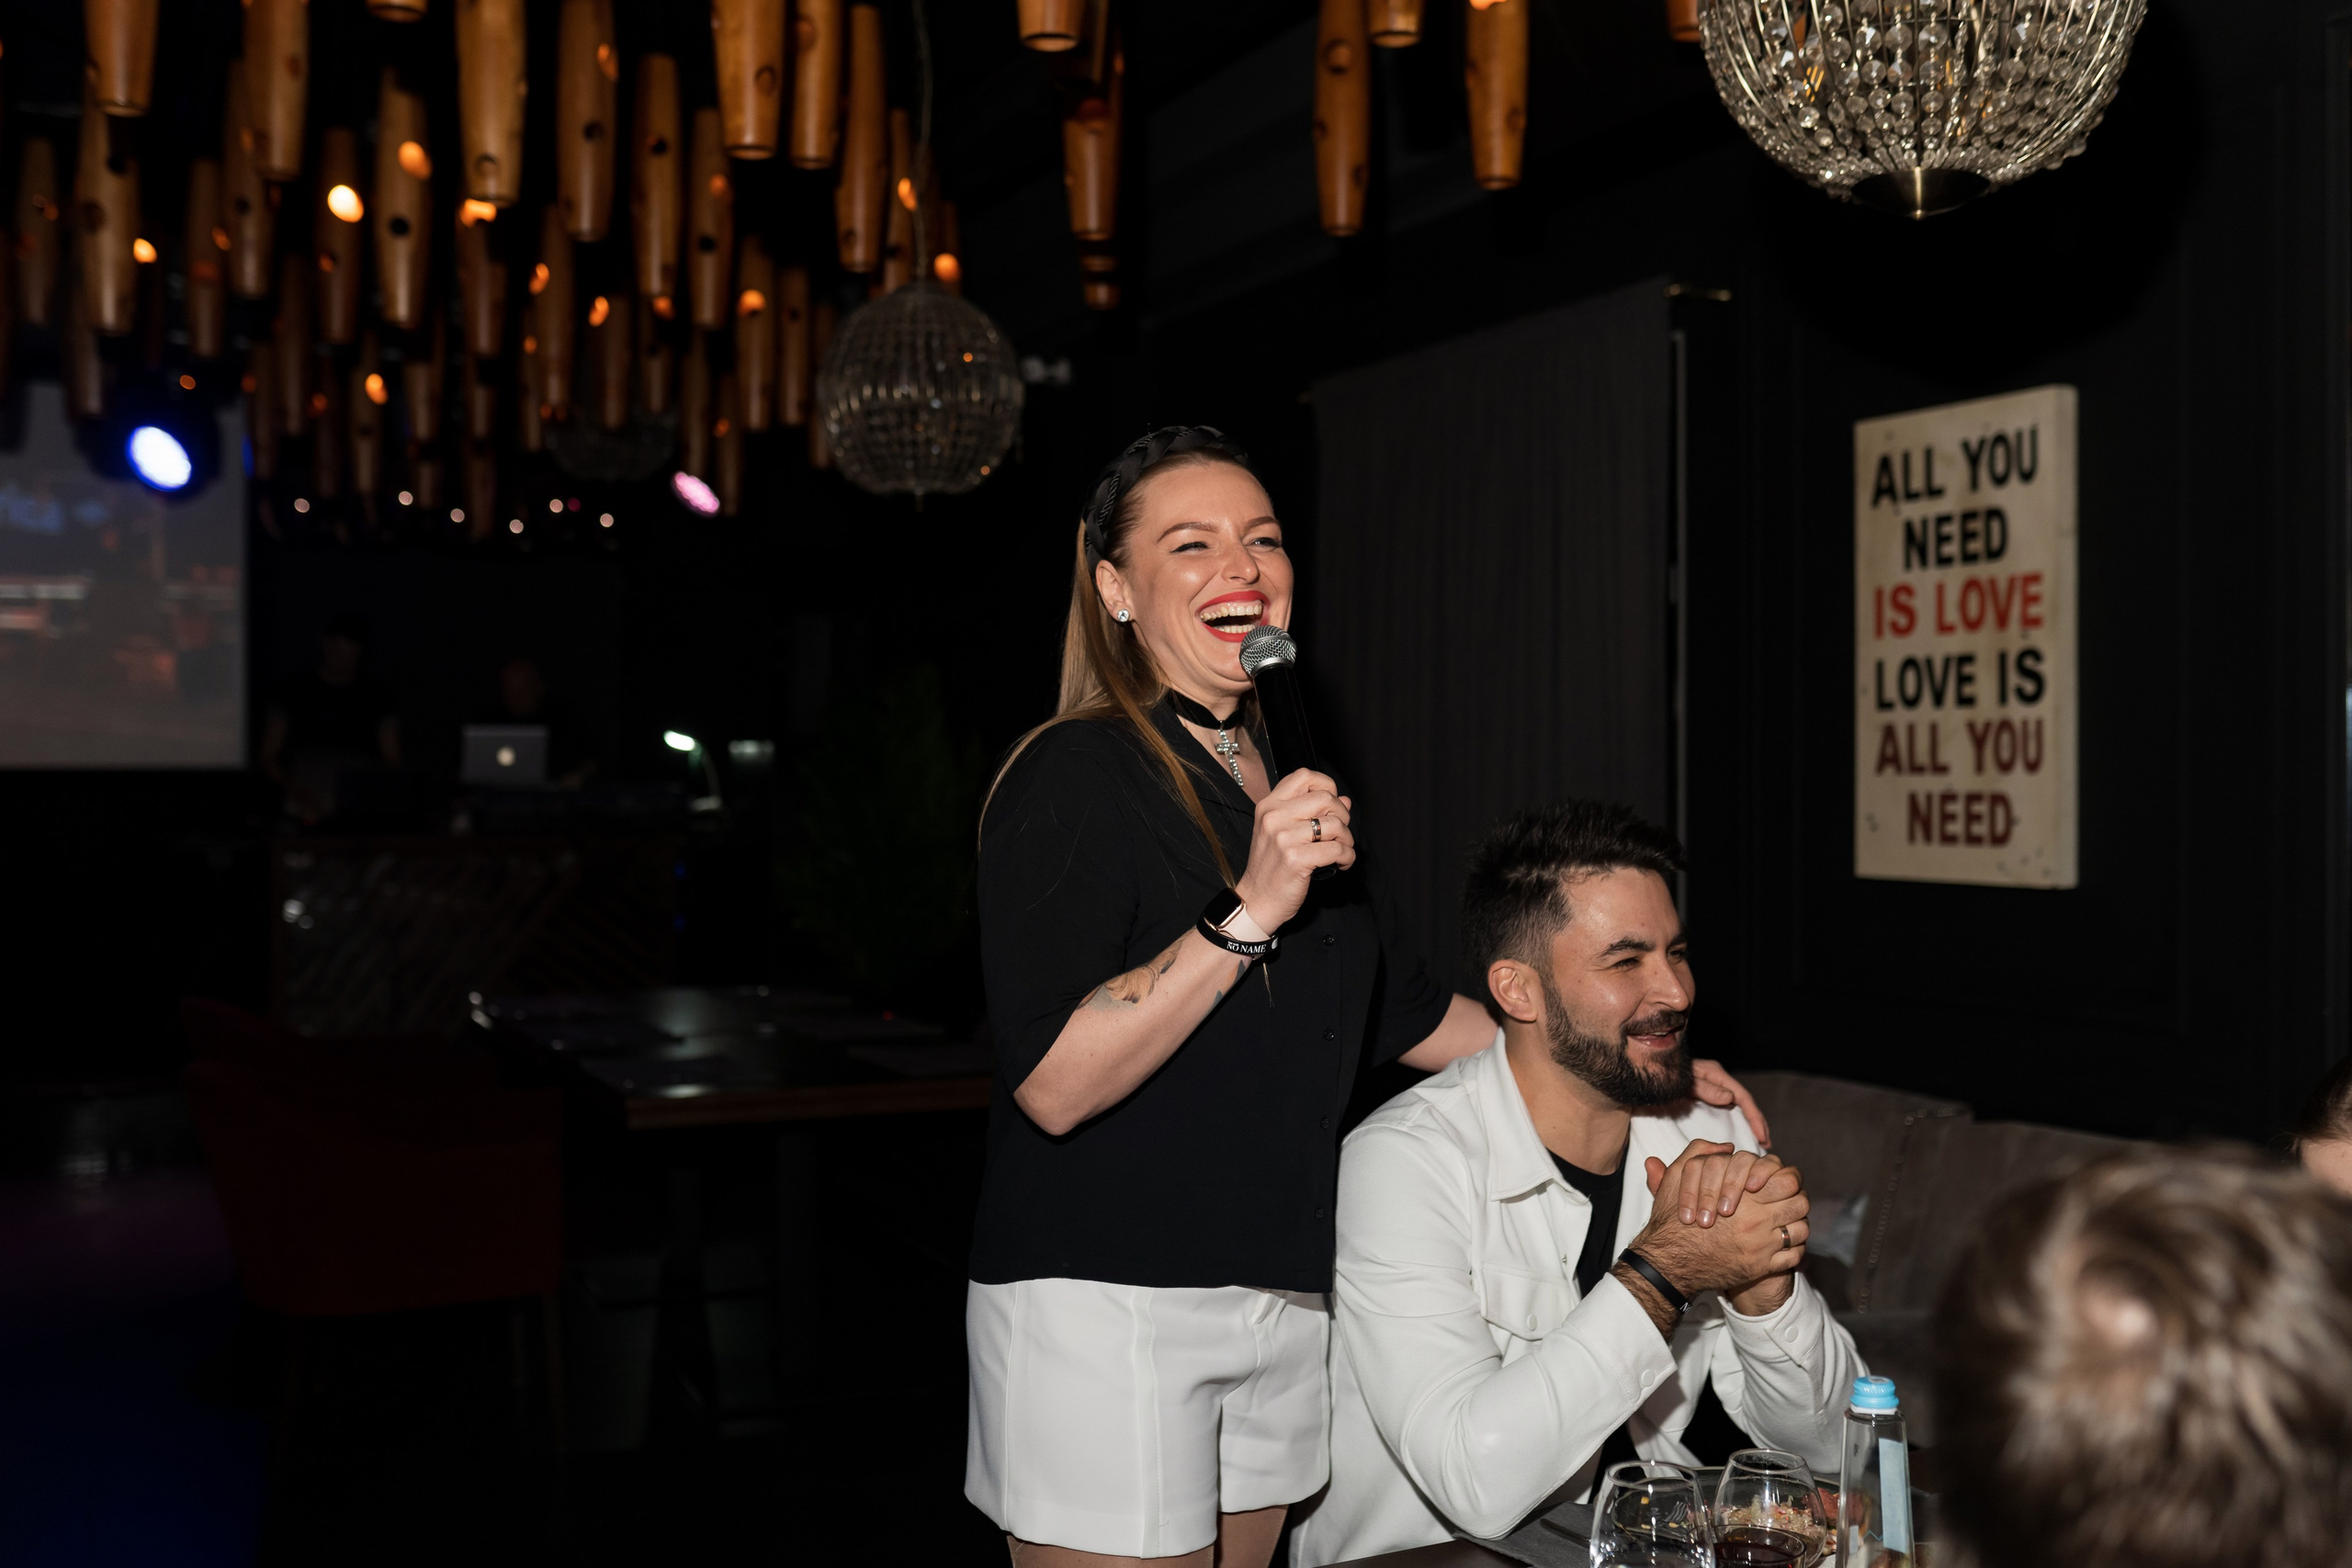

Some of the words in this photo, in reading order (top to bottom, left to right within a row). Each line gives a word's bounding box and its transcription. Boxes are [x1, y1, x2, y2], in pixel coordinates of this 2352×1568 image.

[1871, 446, 1946, 509] ALL
[1961, 427, 2038, 493] YOU
[1904, 506, 2008, 570] NEED
[1874, 584, 1917, 638] IS
[1936, 573, 2043, 635] LOVE
[1875, 653, 1977, 712] LOVE
[1996, 647, 2046, 707] IS
[1875, 723, 1950, 775] ALL
[1966, 718, 2042, 775] YOU
[1908, 790, 2016, 847] NEED
[1240, 944, 1266, 953] NAME
